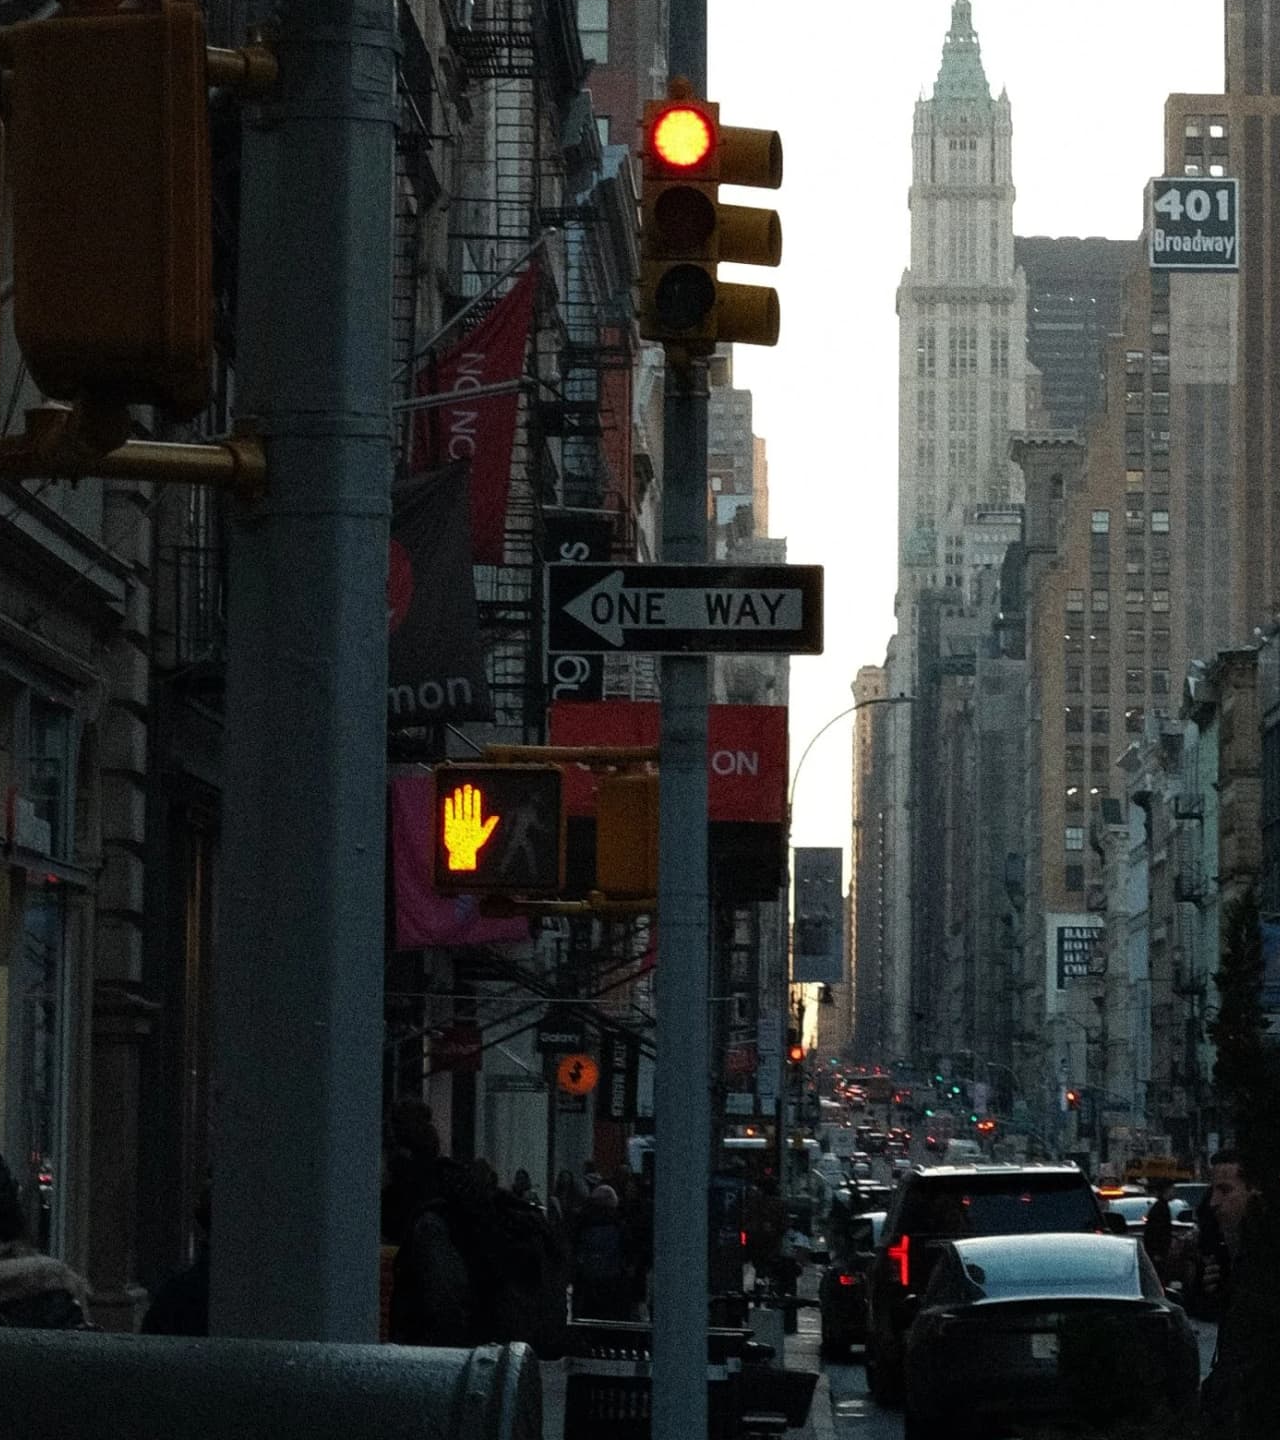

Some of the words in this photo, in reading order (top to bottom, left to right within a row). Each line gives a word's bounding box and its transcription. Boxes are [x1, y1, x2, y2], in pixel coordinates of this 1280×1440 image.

[1154, 188, 1229, 221] 401
[1154, 229, 1235, 259] Broadway
[591, 593, 666, 626] ONE
[705, 593, 786, 626] WAY
